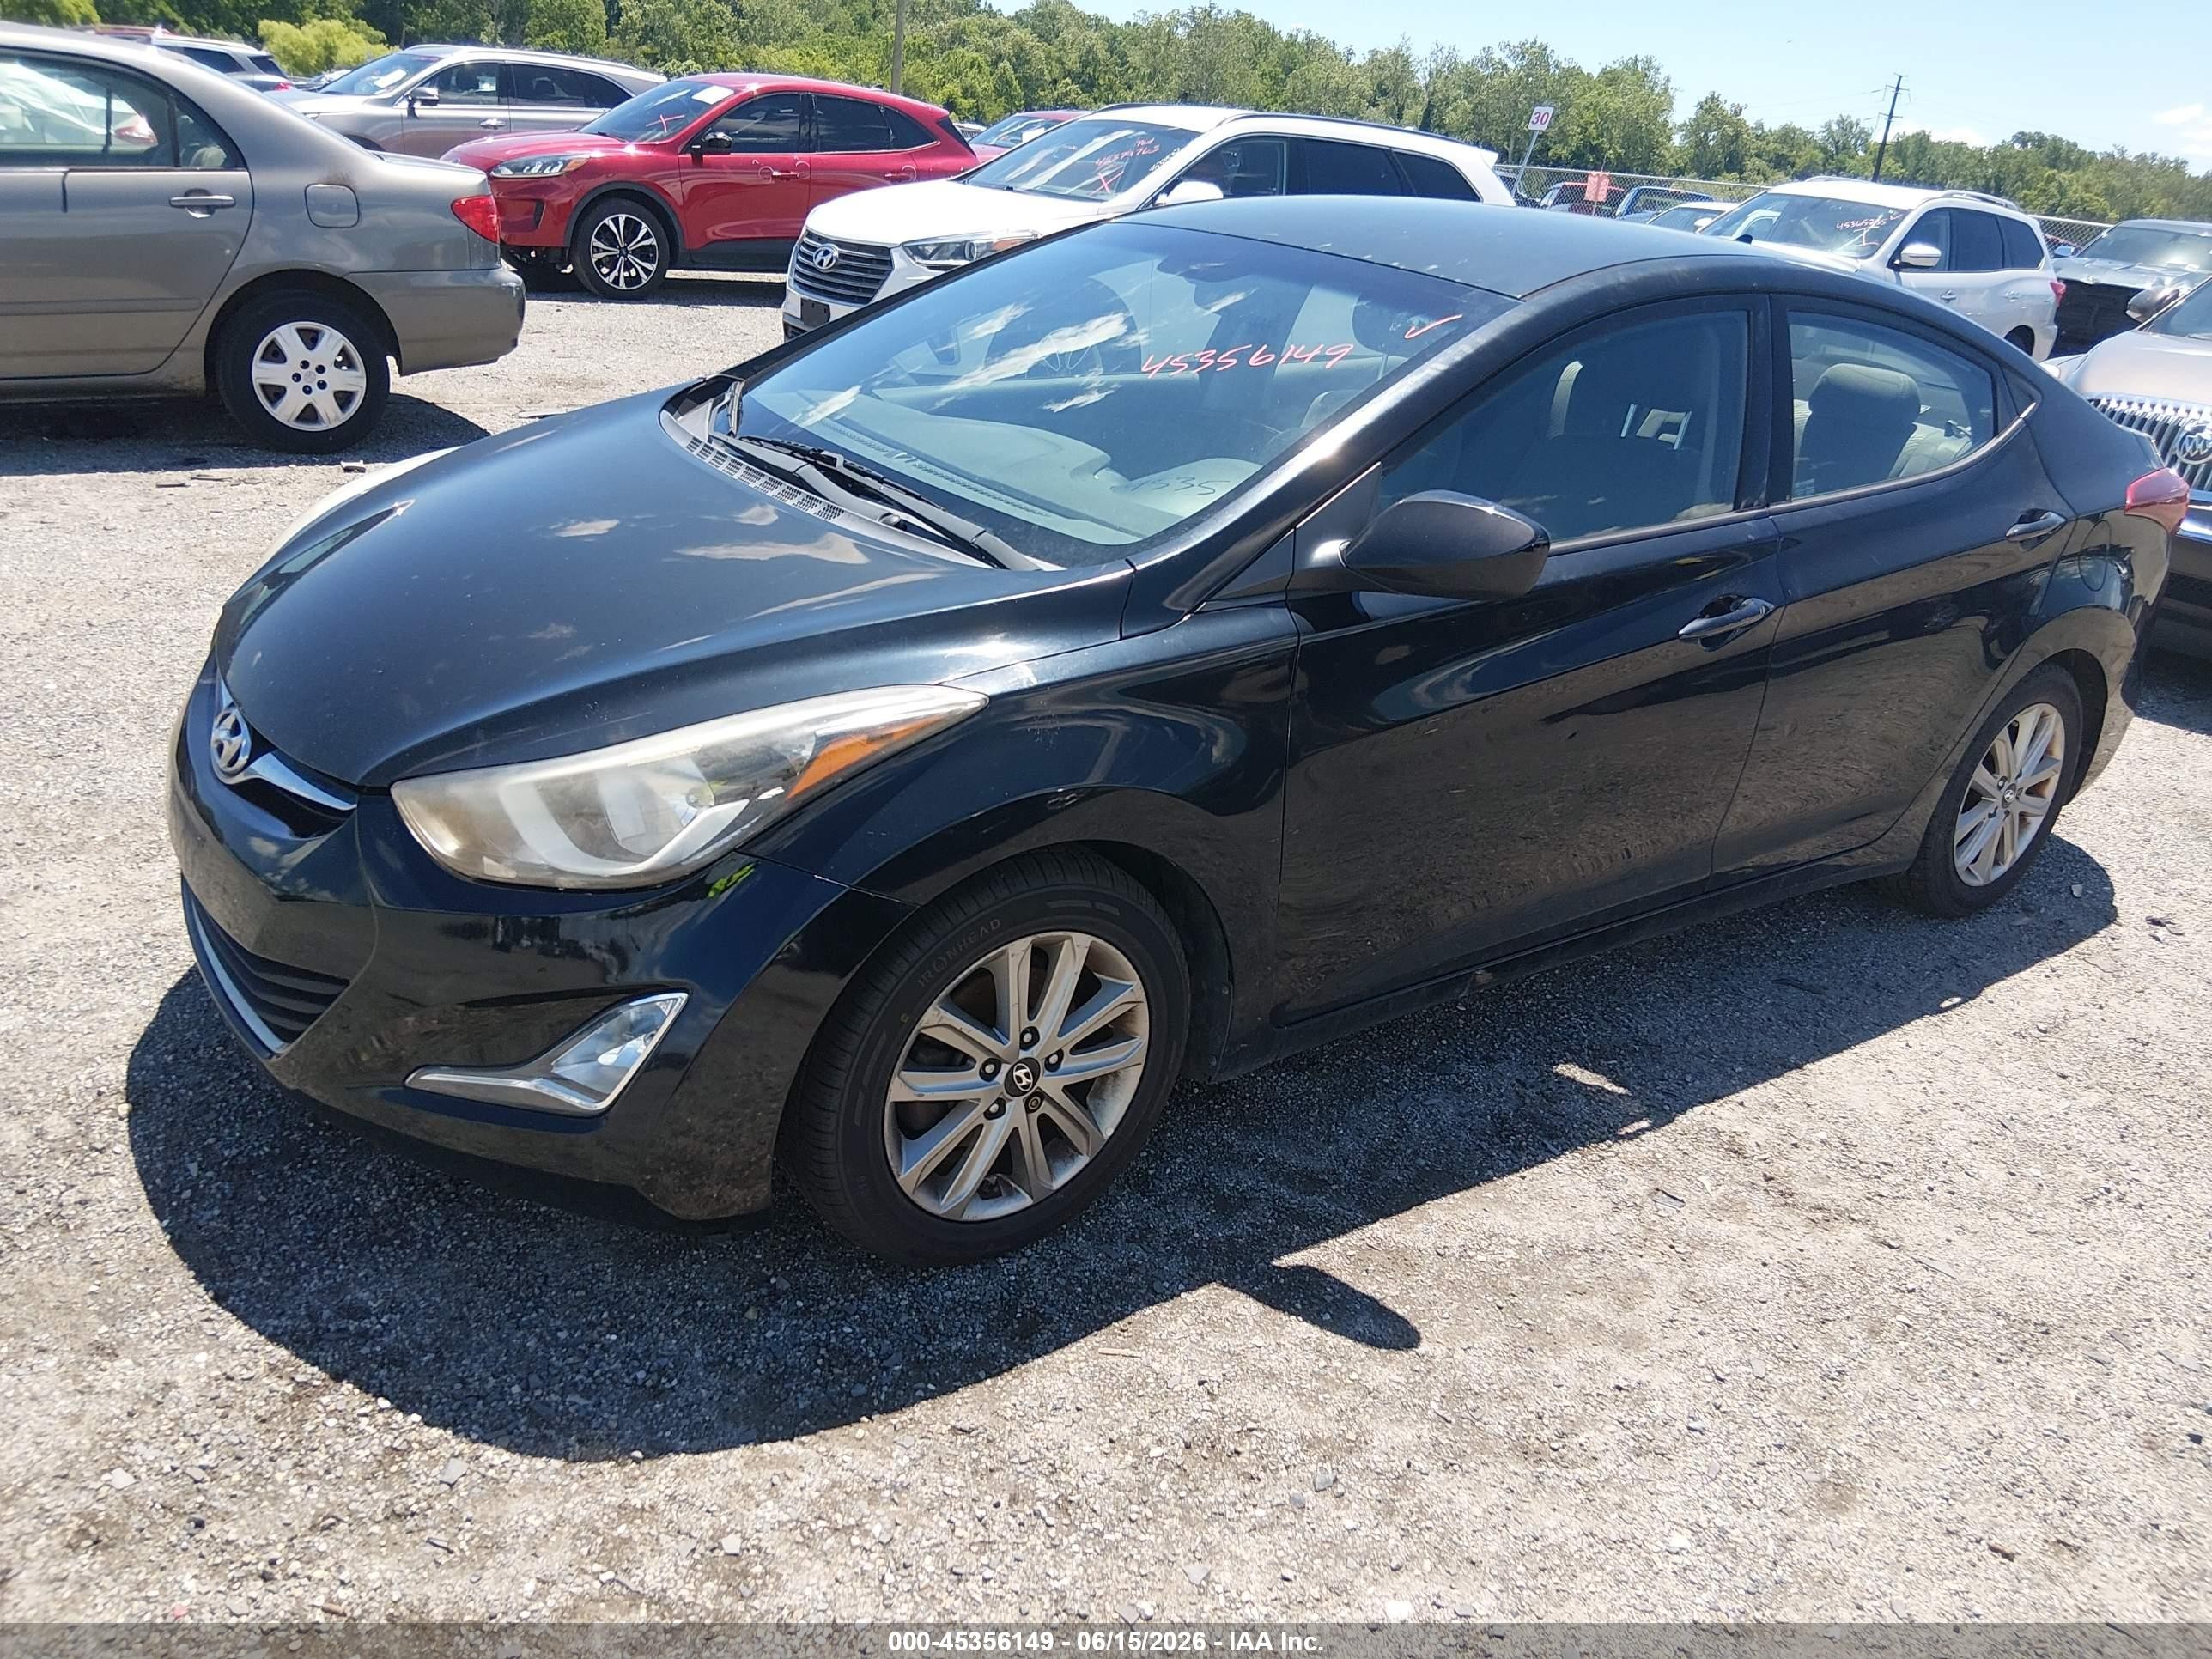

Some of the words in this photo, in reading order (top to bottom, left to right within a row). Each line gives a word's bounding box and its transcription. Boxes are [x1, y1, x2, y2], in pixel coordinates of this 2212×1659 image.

[1531, 112, 1550, 125] 30
[1140, 344, 1354, 379] 45356149
[918, 919, 1001, 988] IRONHEAD
